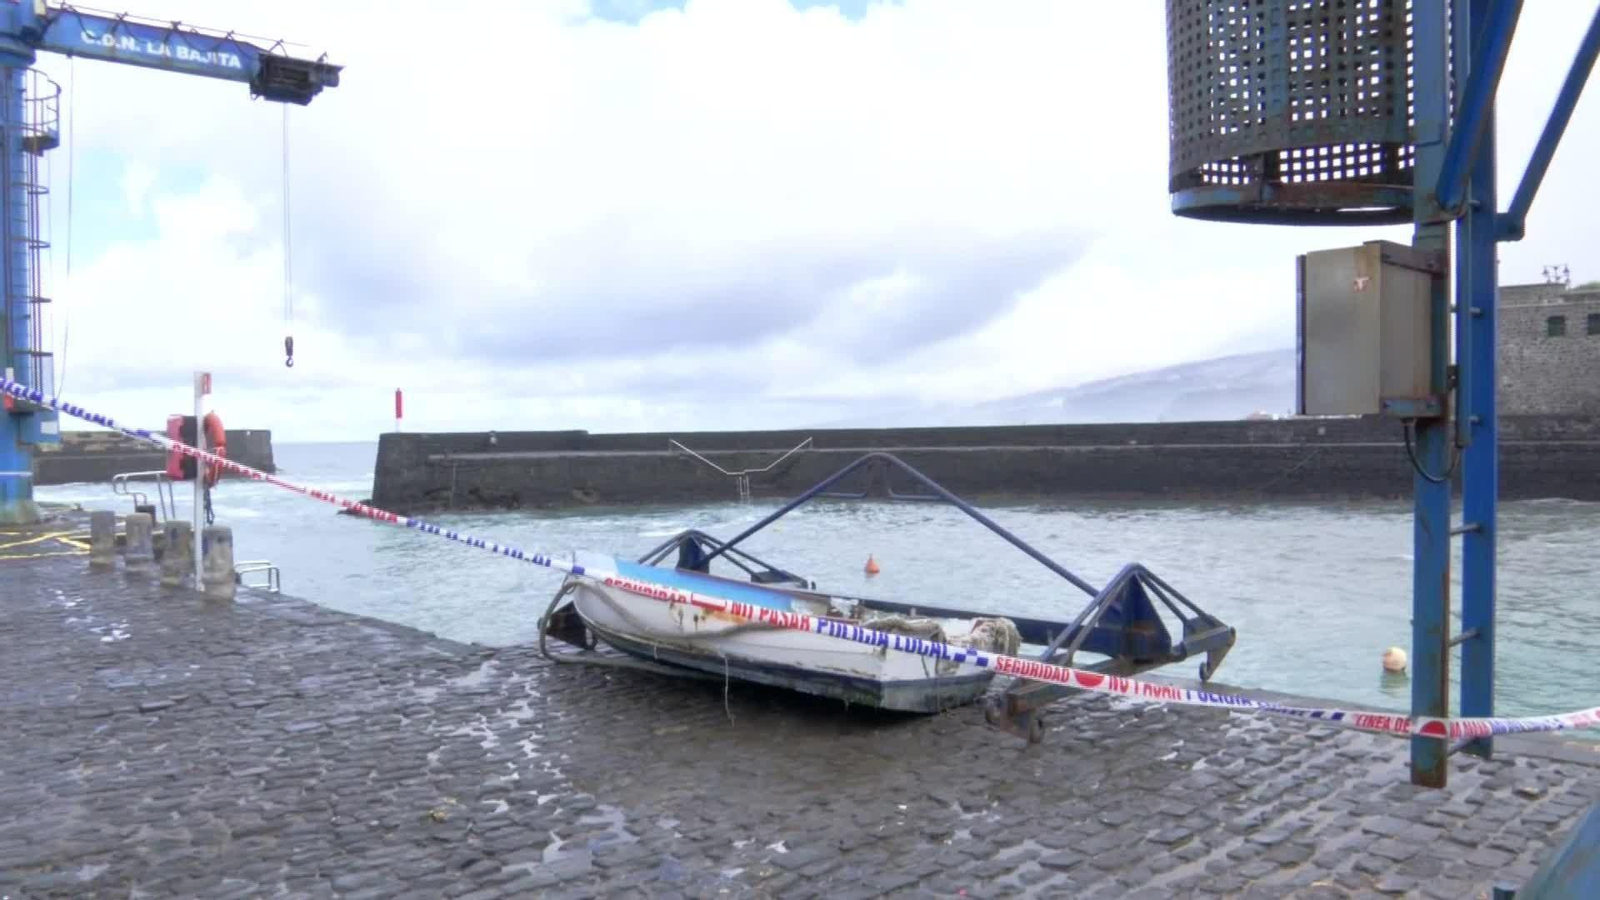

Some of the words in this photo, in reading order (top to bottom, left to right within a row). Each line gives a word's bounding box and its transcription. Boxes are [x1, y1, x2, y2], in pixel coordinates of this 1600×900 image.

[146, 41, 172, 57] LA
[176, 46, 243, 69] BAJITA
[994, 655, 1070, 683] SEGURIDAD
